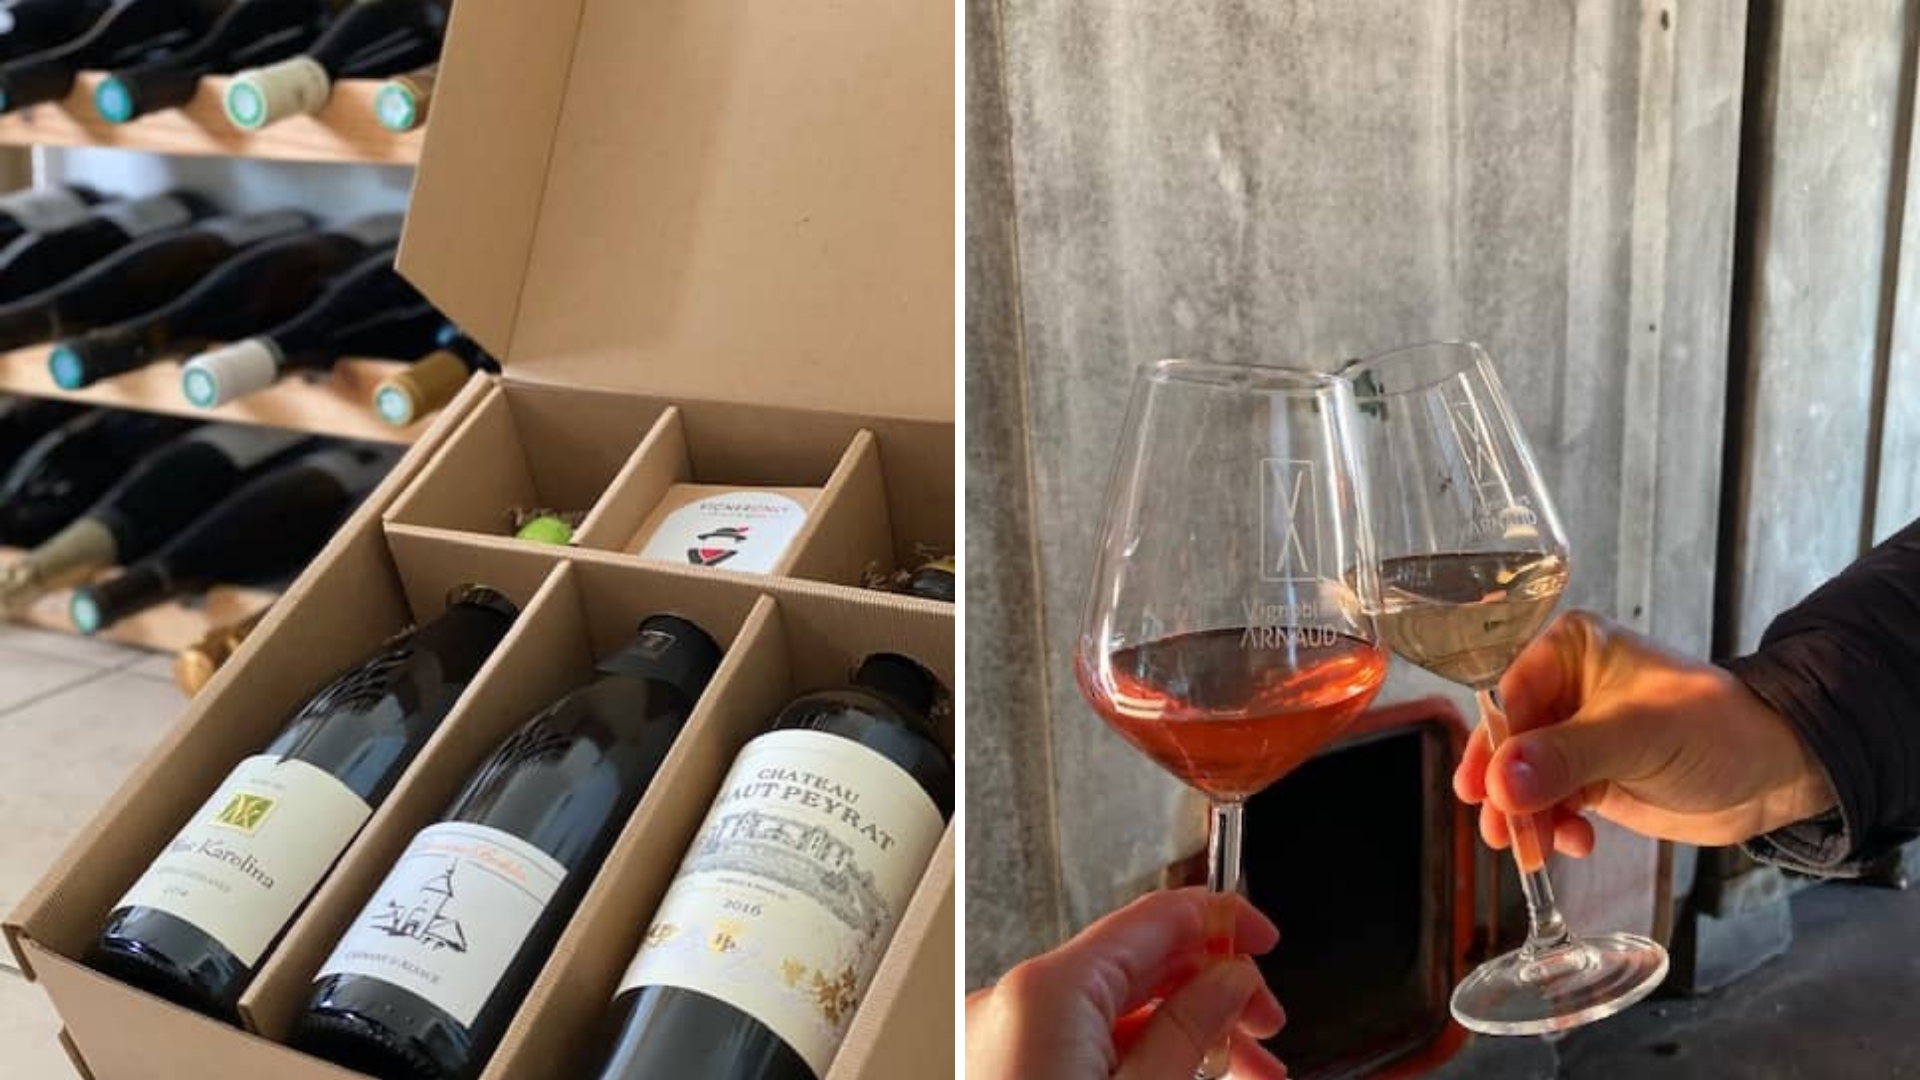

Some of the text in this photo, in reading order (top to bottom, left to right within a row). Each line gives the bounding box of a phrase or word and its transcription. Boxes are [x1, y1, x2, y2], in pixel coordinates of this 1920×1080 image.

[1240, 624, 1338, 649] ARNAUD
[780, 786, 896, 851] PEYRAT
[197, 837, 275, 890] Karolina
[721, 898, 762, 917] 2016
